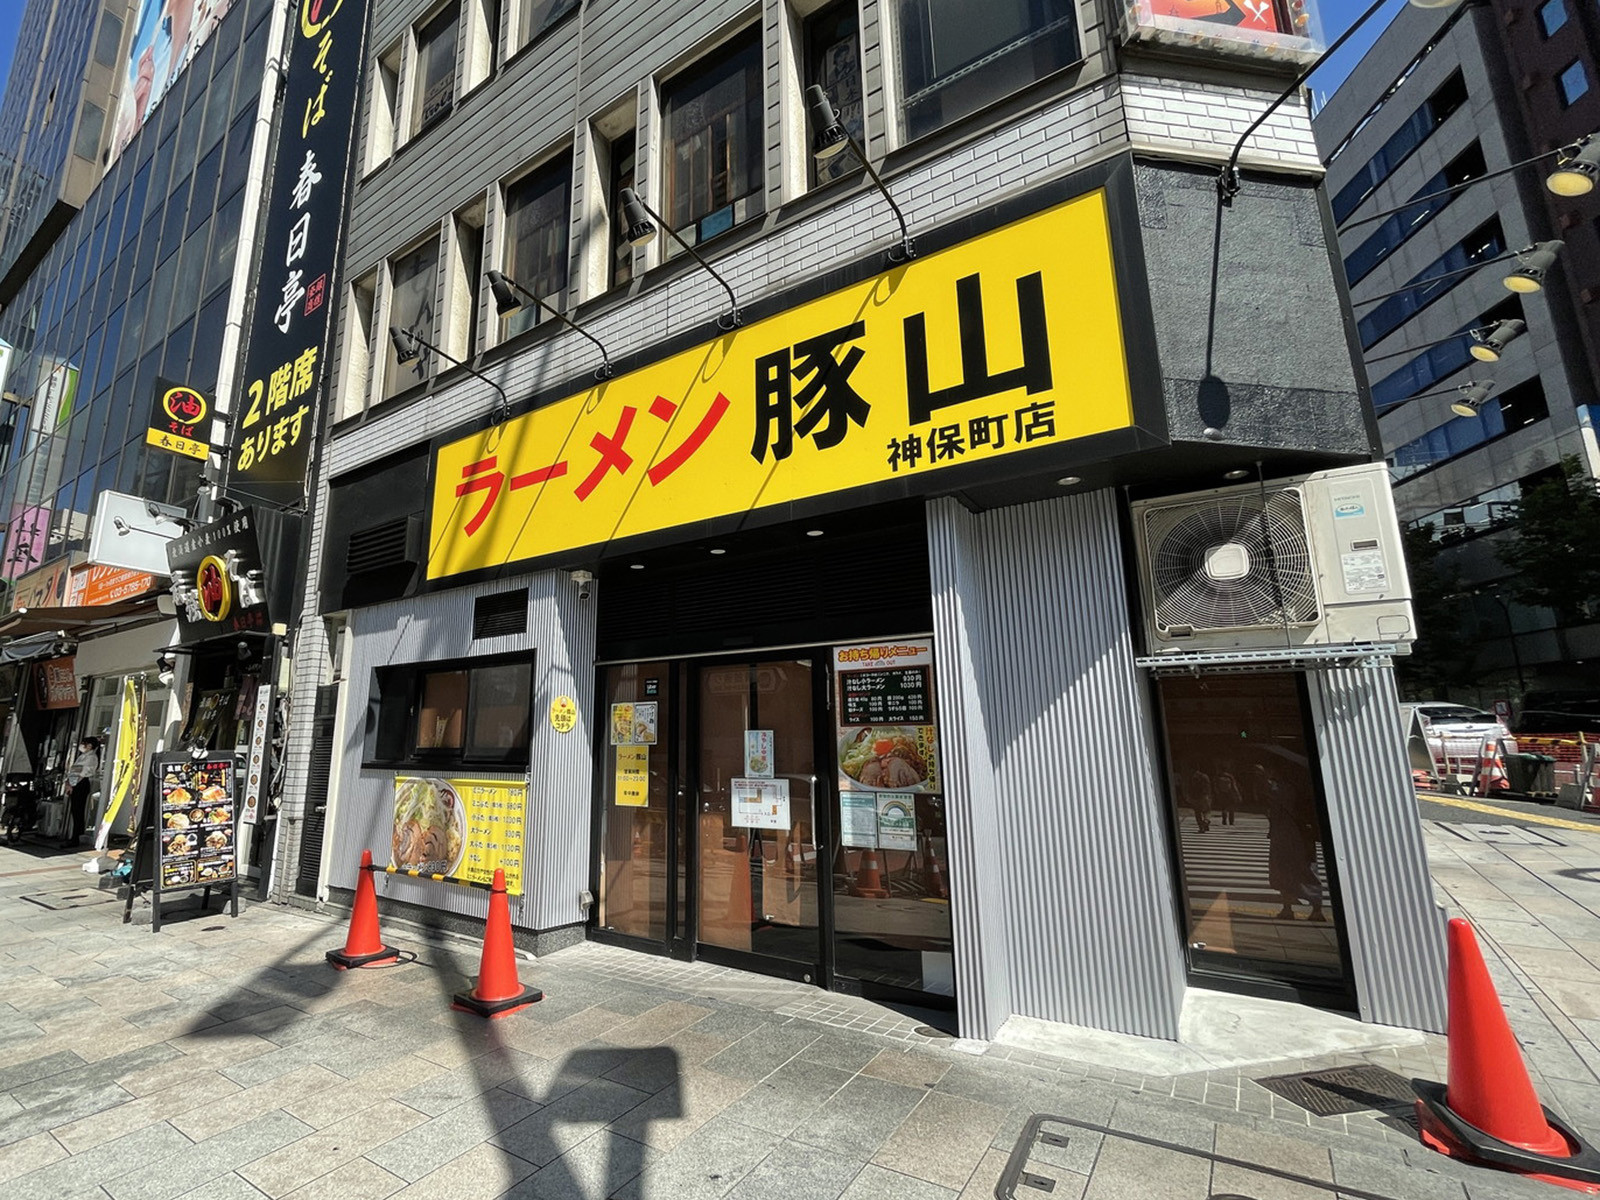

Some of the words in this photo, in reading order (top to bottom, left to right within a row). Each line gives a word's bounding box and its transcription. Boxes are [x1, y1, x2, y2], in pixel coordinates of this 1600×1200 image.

[274, 150, 322, 333] 春日亭
[170, 391, 200, 416] 油
[242, 345, 318, 429] 2階席
[160, 435, 201, 455] 春日亭
[169, 421, 194, 437] そば
[237, 404, 310, 471] あります
[887, 401, 1056, 473] 神保町店
[838, 645, 928, 662] お持ち帰りメニュー
